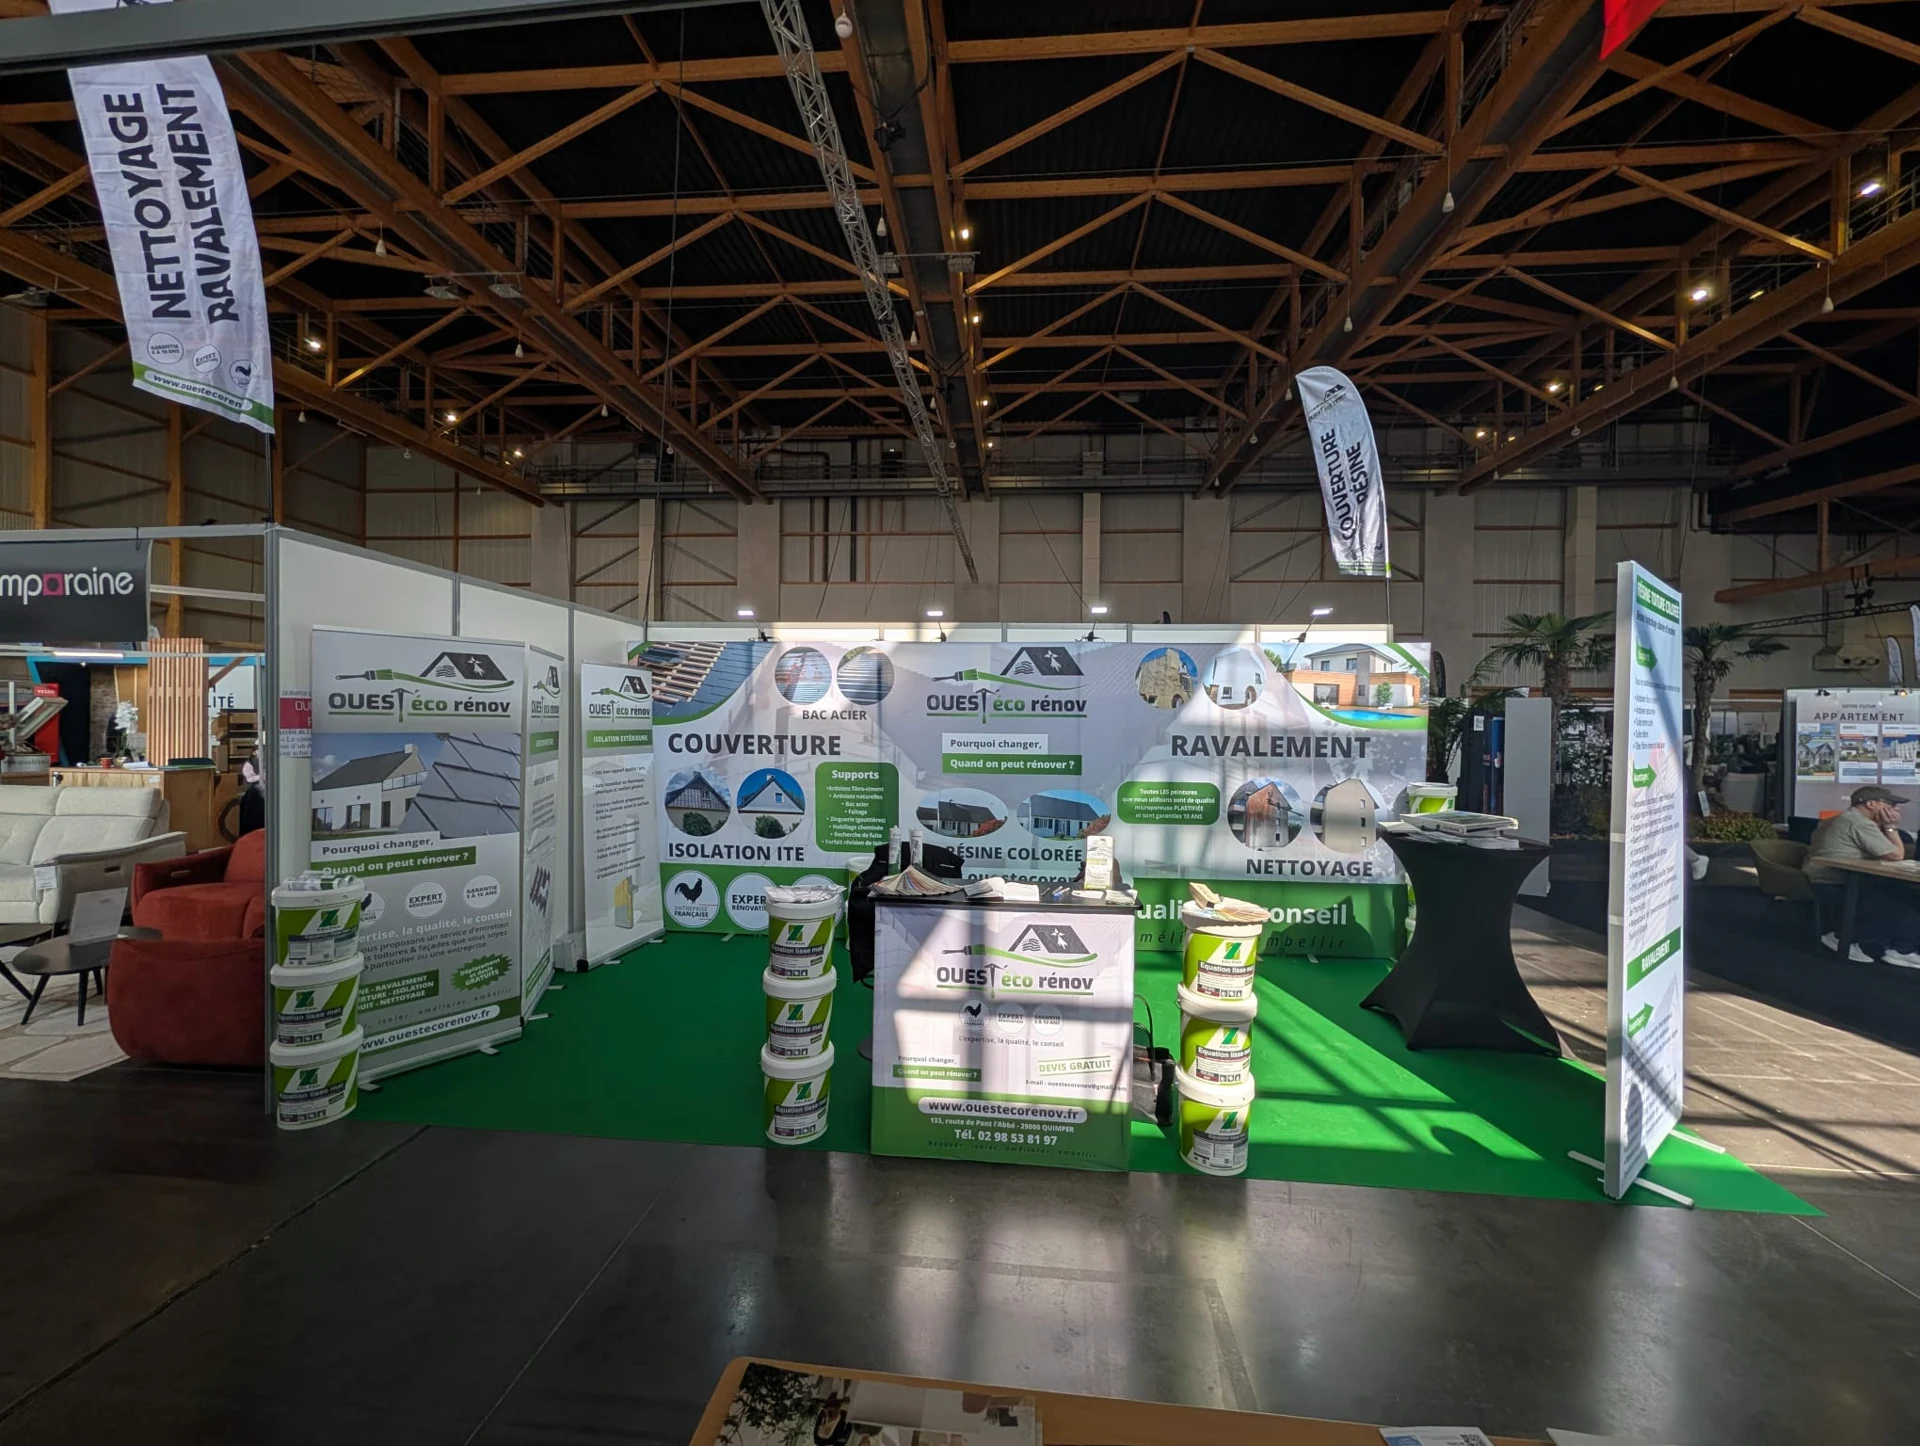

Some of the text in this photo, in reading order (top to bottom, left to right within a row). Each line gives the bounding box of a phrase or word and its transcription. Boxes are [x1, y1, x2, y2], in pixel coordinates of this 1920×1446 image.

[103, 92, 192, 318] NETTOYAGE
[156, 83, 240, 324] RAVALEMENT
[1346, 441, 1369, 506] RÉSINE
[1321, 428, 1357, 540] COUVERTURE
[207, 693, 234, 708] ITÉ
[328, 688, 511, 722] OUEST éco rénov
[926, 688, 1087, 724] OUEST éco rénov
[630, 704, 651, 716] rénov
[802, 709, 868, 721] BAC ACIER
[1814, 712, 1905, 722] APPARTEMENT
[593, 735, 620, 743] ISOLATION
[668, 732, 841, 756] COUVERTURE
[950, 739, 1042, 750] Pourquoi changer,
[1171, 735, 1371, 758] RAVALEMENT
[950, 758, 1075, 771] Quand on peut rénover ?
[832, 770, 879, 781] Supports
[322, 838, 434, 855] Pourquoi changer,
[669, 842, 805, 862] ISOLATION ITE
[1007, 845, 1083, 862] COLORÉE
[322, 854, 460, 876] Quand on peut rénover
[1246, 858, 1373, 877] NETTOYAGE
[409, 892, 443, 903] EXPERT
[402, 926, 413, 936] la
[416, 919, 460, 935] qualité,
[463, 916, 473, 924] le
[475, 909, 512, 923] conseil
[674, 911, 709, 919] FRANÇAISE
[380, 937, 425, 952] proposons
[440, 929, 467, 940] service
[469, 922, 509, 935] d'entretien
[374, 949, 408, 961] toitures
[419, 941, 449, 953] façades
[451, 938, 466, 948] que
[487, 931, 508, 940] soyez
[370, 955, 414, 971] particulier
[429, 950, 445, 958] une
[1641, 940, 1671, 972] RAVALEMENT
[1200, 962, 1230, 973] Equation
[375, 975, 428, 991] RAVALEMENT
[465, 969, 499, 986] GRATUITS
[937, 964, 1094, 998] OUEST éco rénov
[393, 981, 434, 995] ISOLATION
[380, 990, 426, 1006] NETTOYAGE
[958, 1035, 996, 1044] L'expertise,
[1006, 1038, 1031, 1046] qualité,
[1040, 1039, 1064, 1047] conseil
[1198, 1048, 1229, 1058] Equation
[1039, 1059, 1111, 1072] DEVIS GRATUIT
[928, 1100, 1079, 1120] www.ouestecorenov.fr
[994, 1120, 1015, 1129] l'Abbé
[1020, 1123, 1040, 1131] 29000
[1042, 1125, 1074, 1133] QUIMPER
[954, 1129, 1058, 1145] Tél. 02 98 53 81 97
